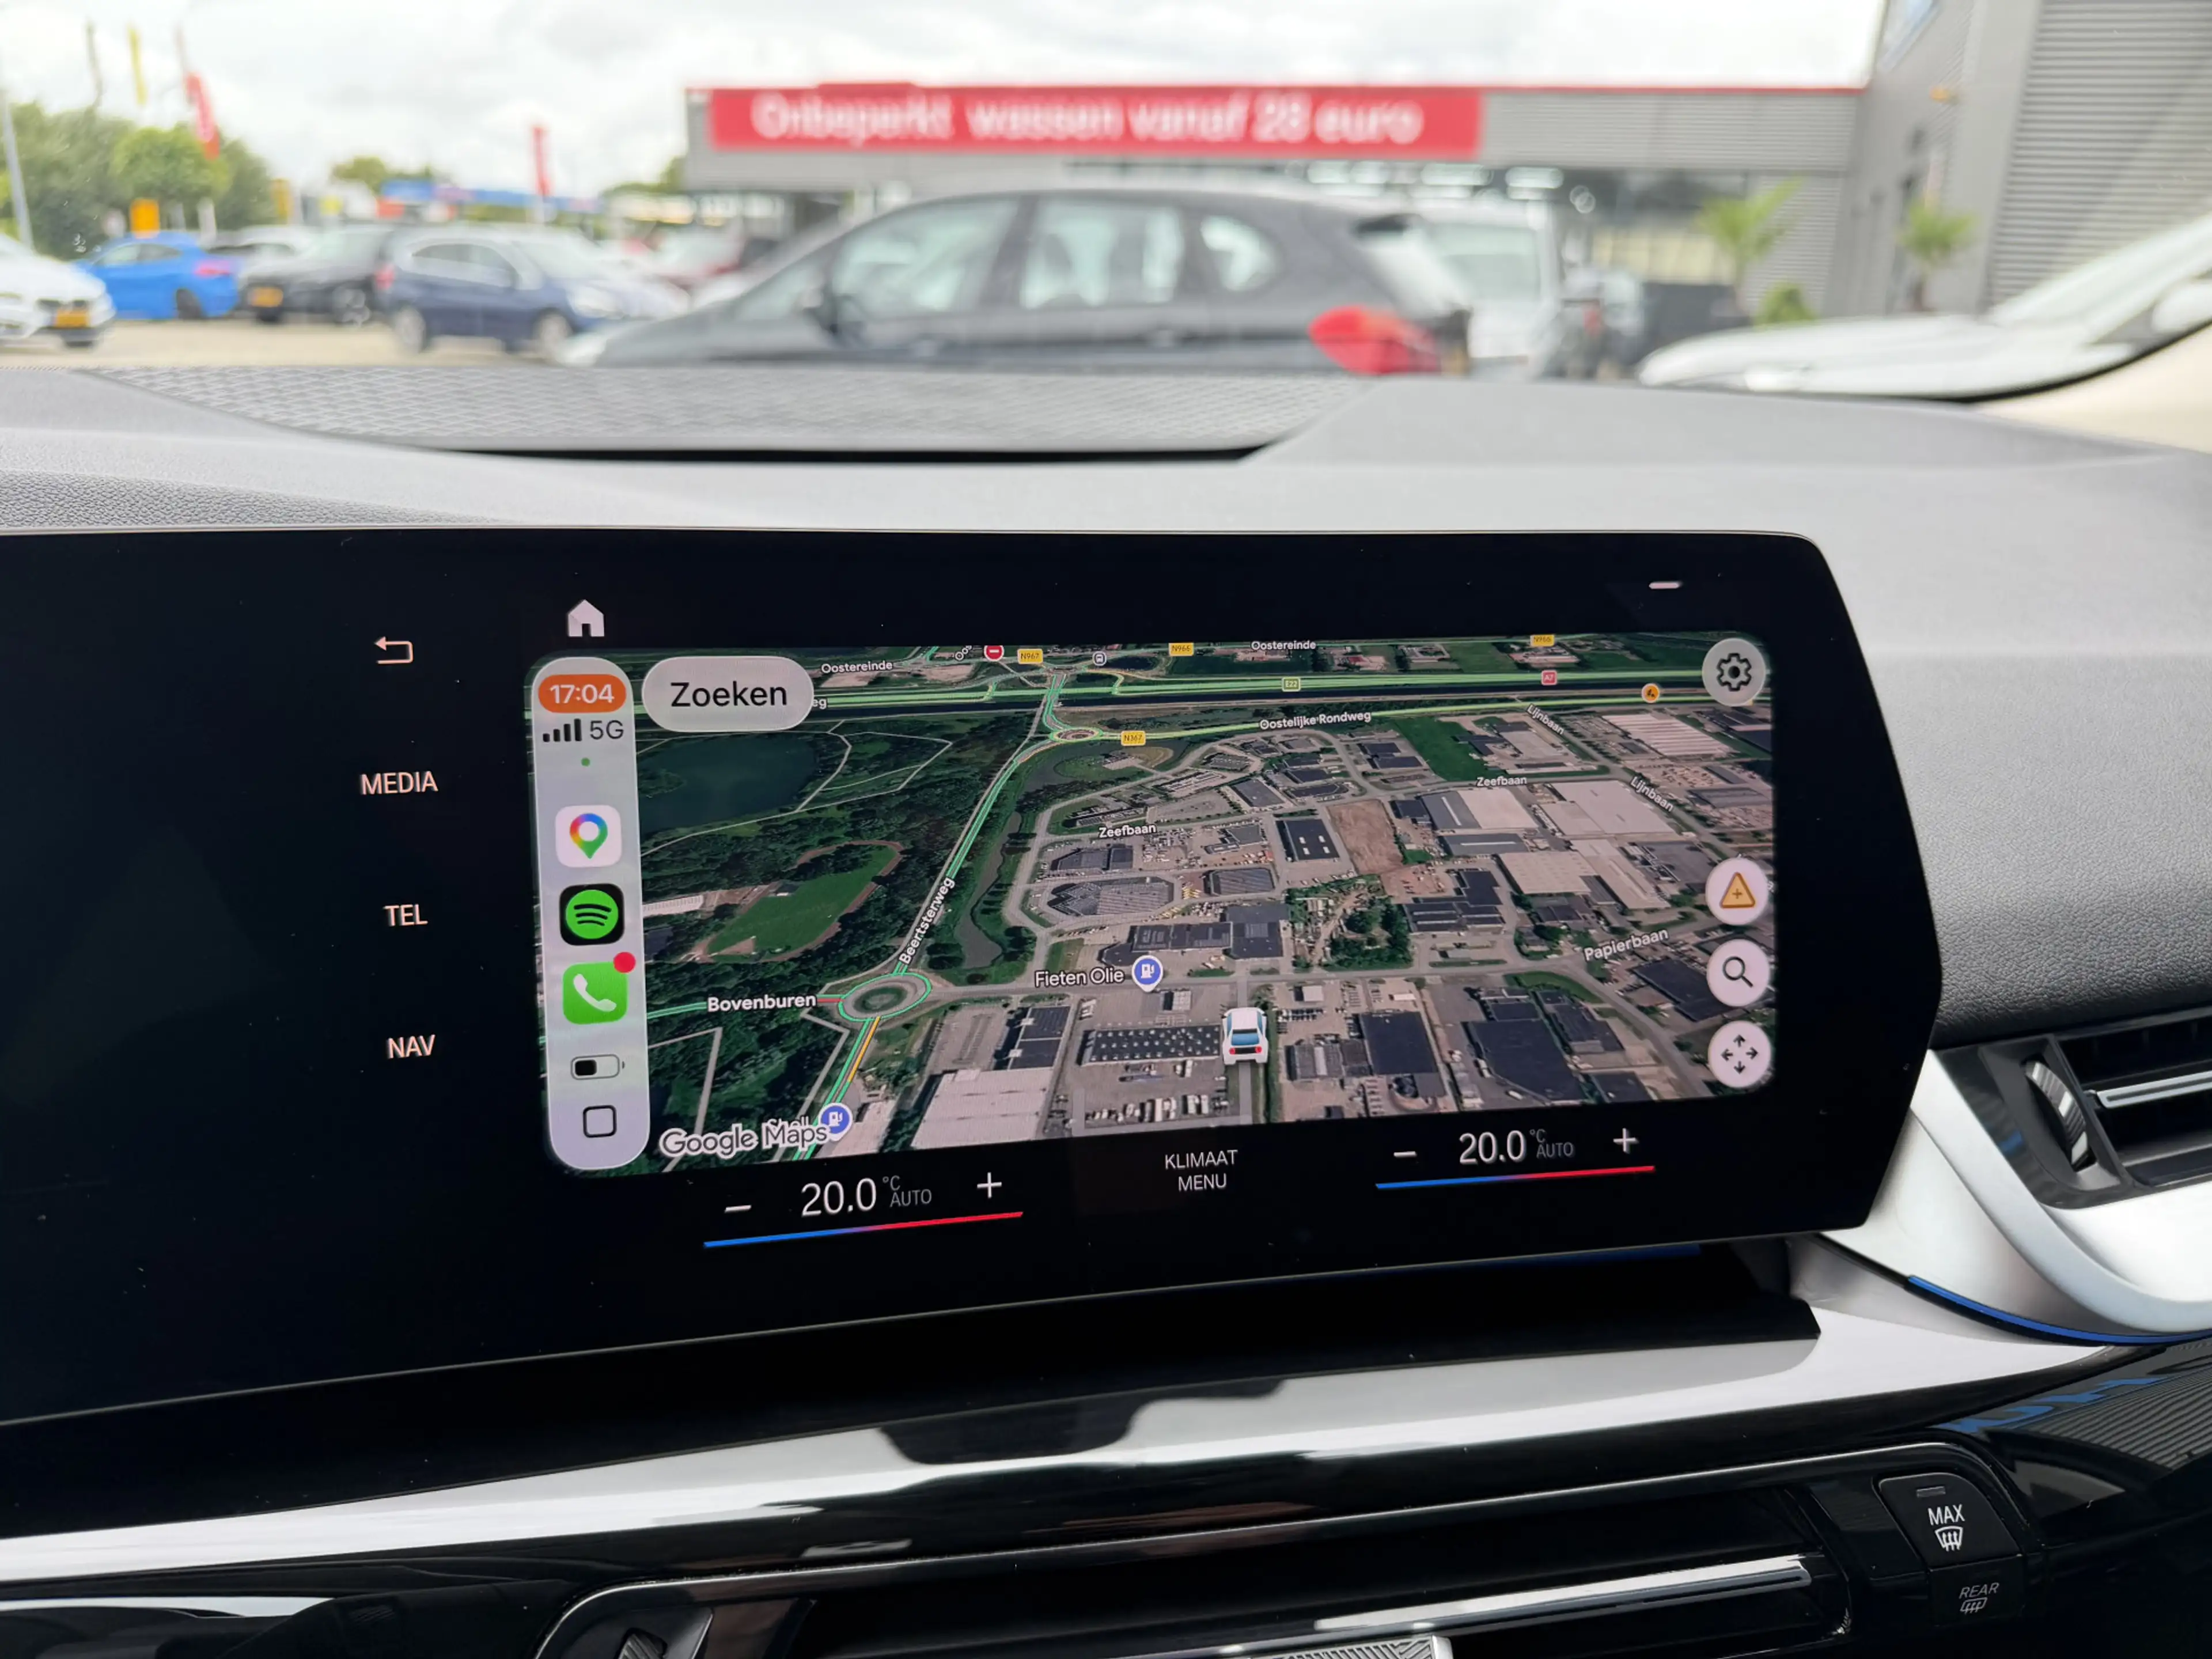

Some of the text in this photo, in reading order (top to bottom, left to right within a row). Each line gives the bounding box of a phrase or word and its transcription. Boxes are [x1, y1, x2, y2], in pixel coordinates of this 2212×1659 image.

[753, 91, 1424, 147] Onbeperkt wassen vanaf 28 euro
[1251, 641, 1316, 650] Oostereinde
[821, 660, 893, 673] Oostereinde
[549, 684, 615, 704] 17:04
[1285, 680, 1298, 688] E22
[671, 681, 787, 708] Zoeken
[590, 719, 624, 740] 5G
[1260, 712, 1372, 729] Oostelijke Rondweg
[1527, 704, 1565, 735] Lijnbaan
[361, 771, 438, 795] MEDIA
[1476, 776, 1528, 787] Zeefbaan
[1630, 776, 1673, 812] Lijnbaan
[1099, 824, 1157, 838] Zeefbaan
[384, 904, 427, 927] TEL
[899, 878, 956, 964] Beertsterweg
[1584, 928, 1669, 961] Papierbaan
[1035, 968, 1124, 988] Fieten Olie
[707, 994, 816, 1012] Bovenburen
[388, 1035, 435, 1059] NAV
[662, 1123, 827, 1156] Google Maps
[1459, 1130, 1526, 1164] 20.0
[1165, 1150, 1238, 1170] KLIMAAT
[1536, 1142, 1575, 1158] AUTO
[1177, 1173, 1228, 1192] MENU
[801, 1177, 877, 1218] 20.0
[890, 1189, 932, 1207] AUTO
[1927, 1504, 1965, 1525] MAX
[1959, 1582, 1999, 1600] REAR
